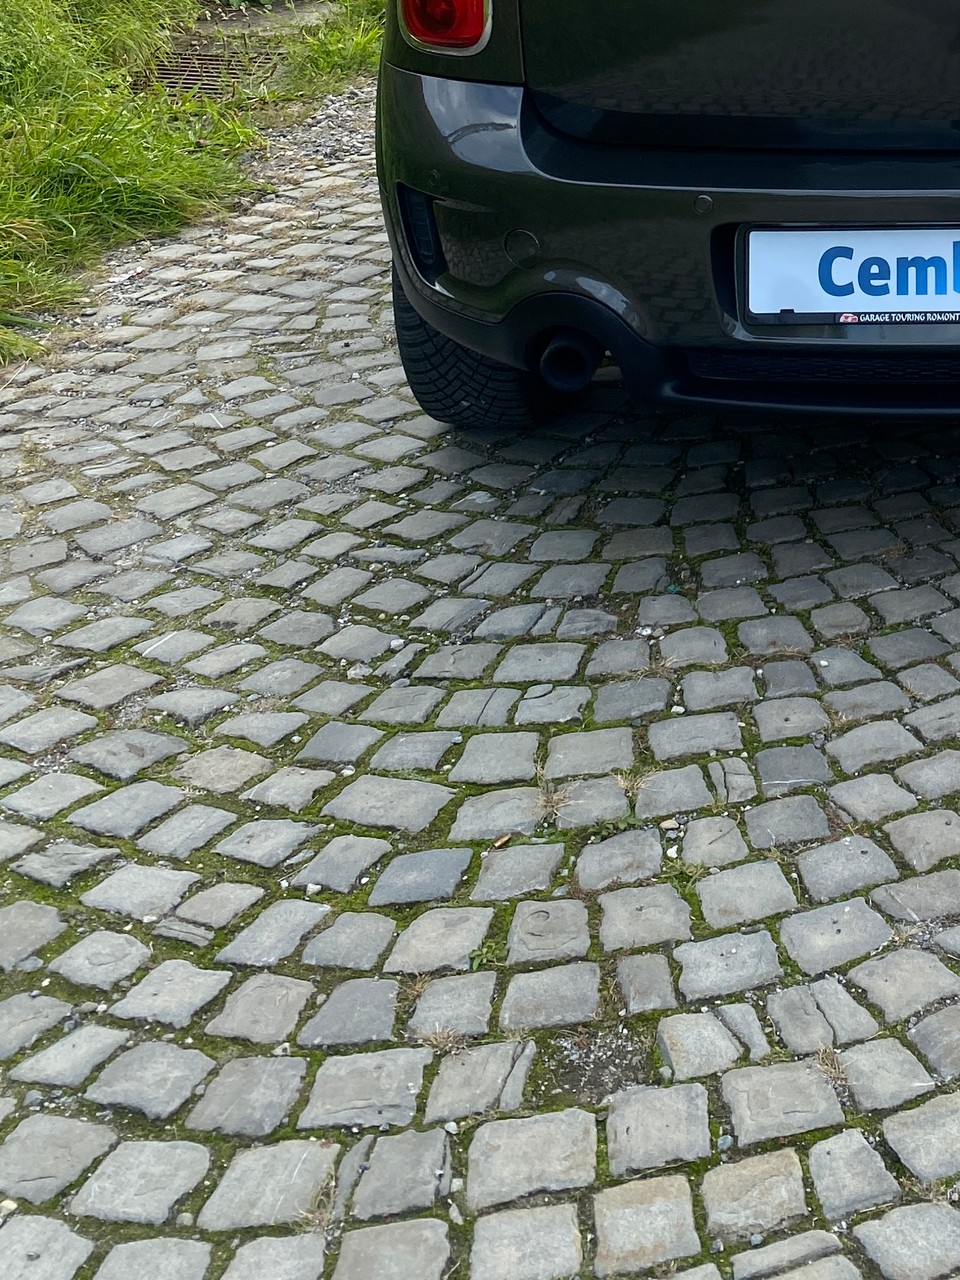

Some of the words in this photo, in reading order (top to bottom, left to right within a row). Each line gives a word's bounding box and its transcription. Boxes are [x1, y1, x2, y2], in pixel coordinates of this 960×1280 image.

[860, 313, 890, 322] GARAGE
[891, 313, 925, 322] TOURING
[926, 312, 960, 321] ROMONT
